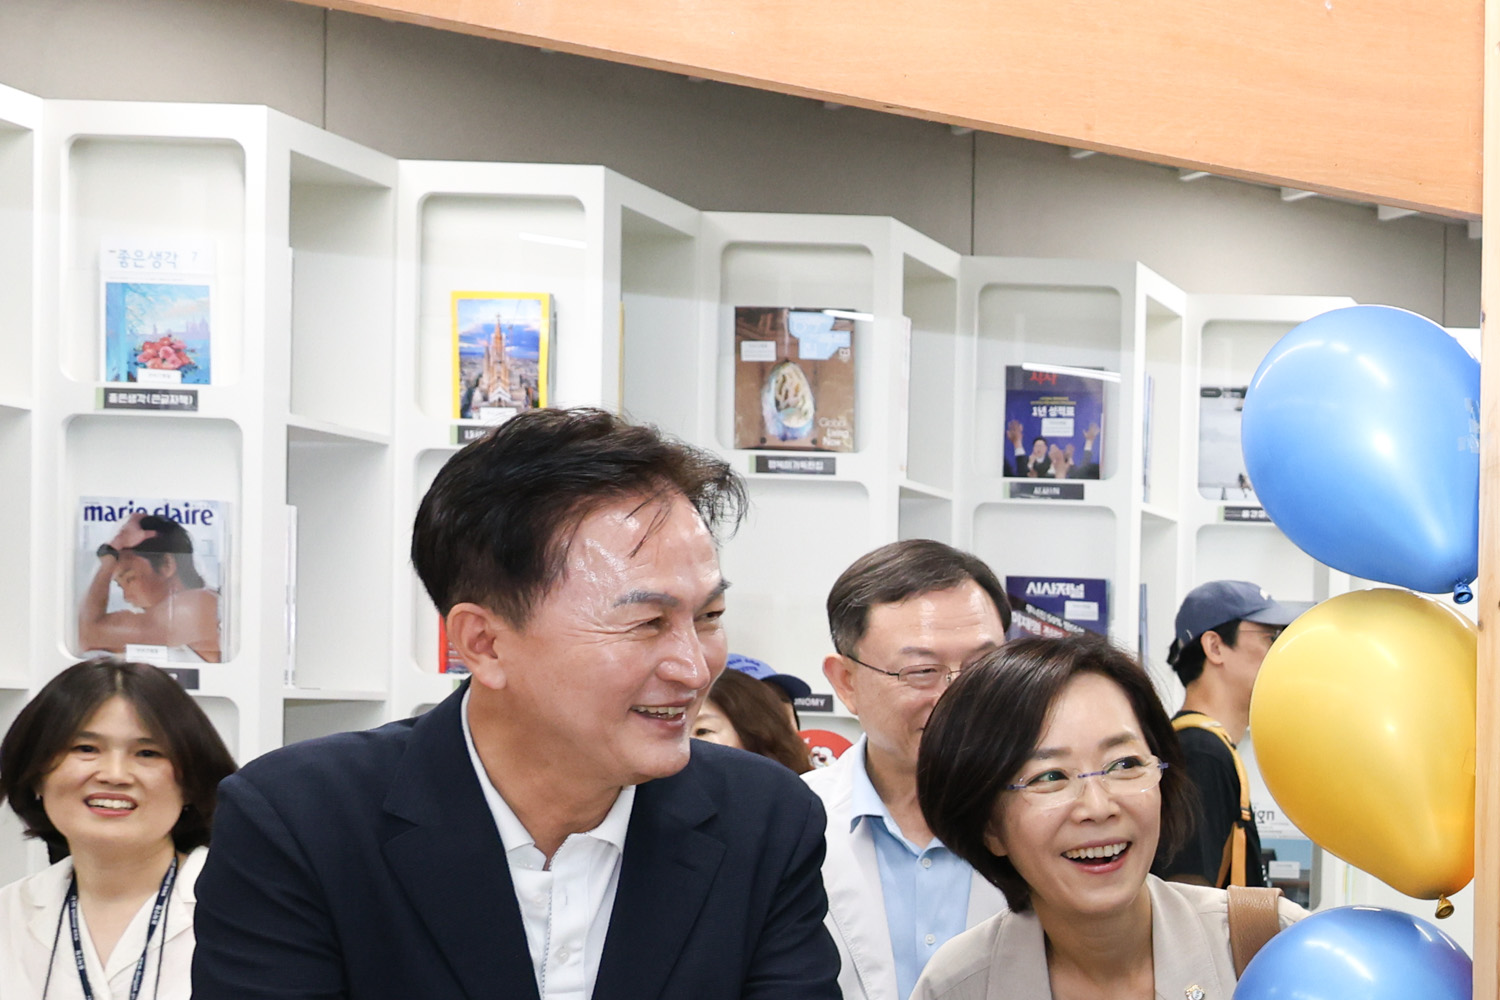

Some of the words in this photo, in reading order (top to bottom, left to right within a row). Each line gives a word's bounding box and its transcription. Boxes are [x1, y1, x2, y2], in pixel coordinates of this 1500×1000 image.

[117, 249, 178, 269] 좋은생각
[1031, 405, 1047, 418] 1년
[154, 502, 214, 526] claire
[1025, 581, 1085, 600] 시사저널
